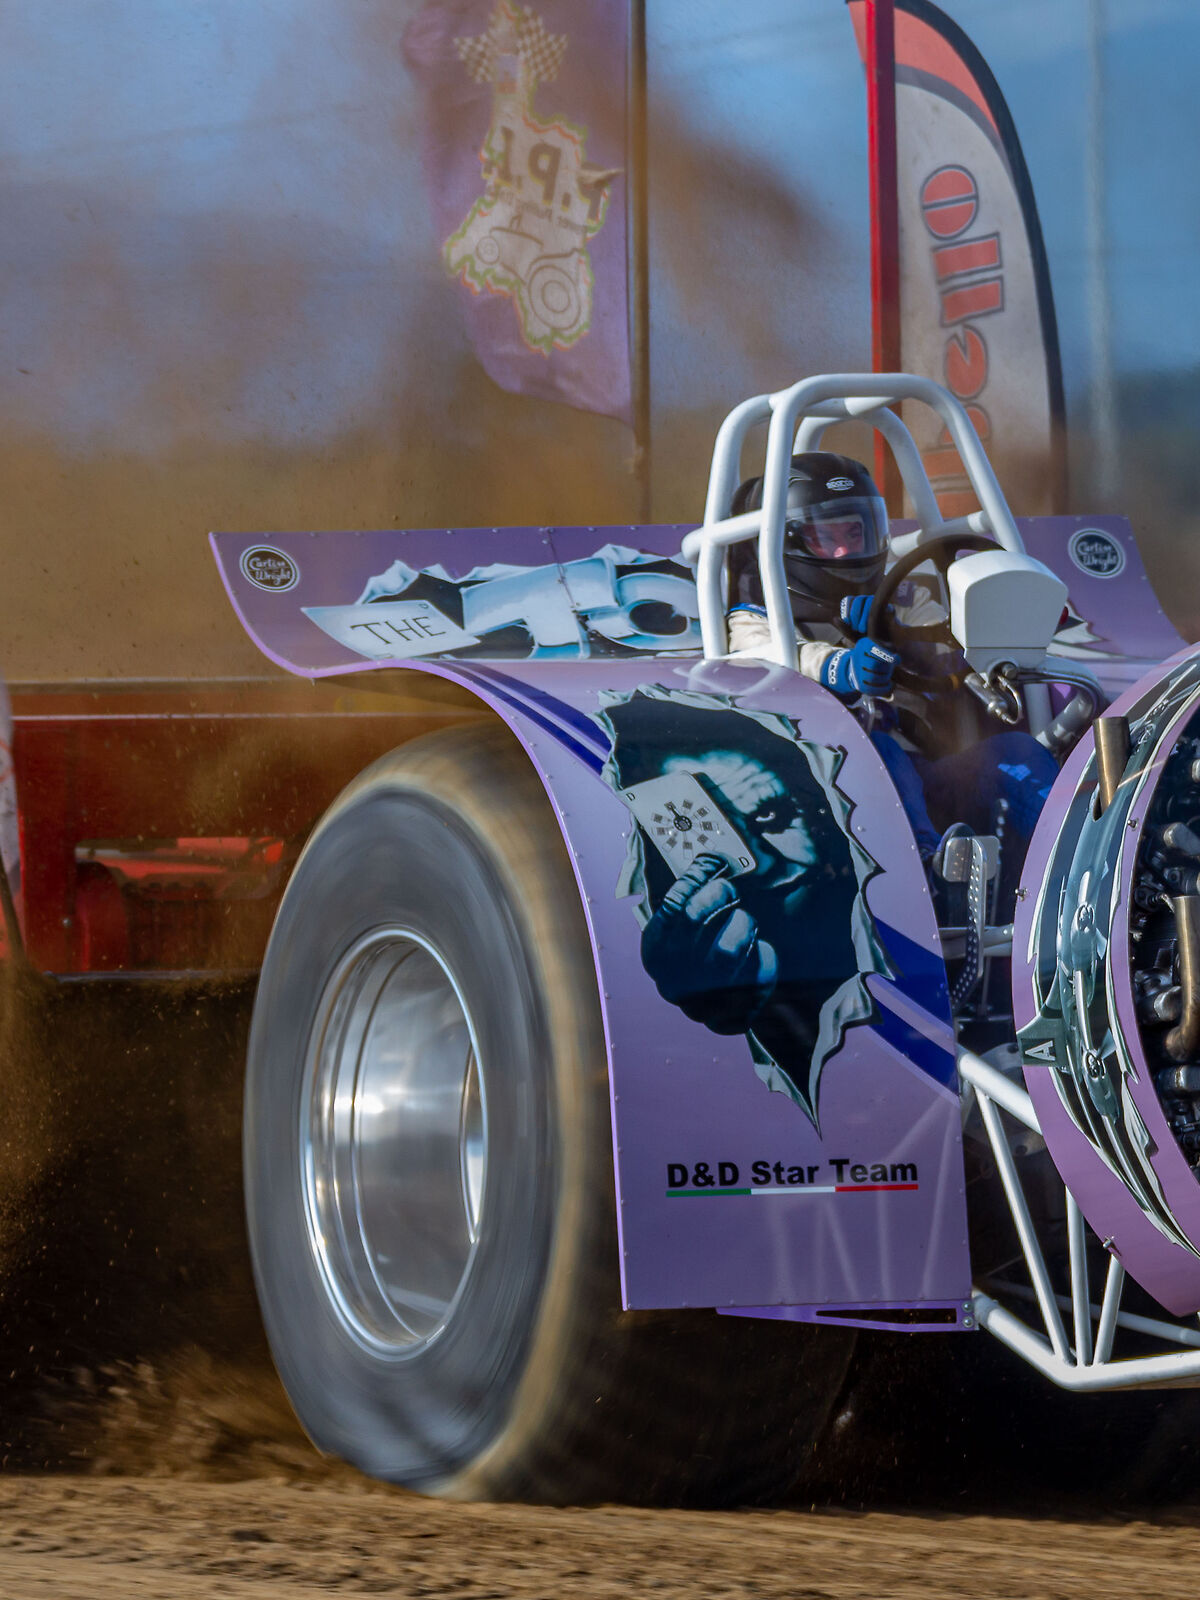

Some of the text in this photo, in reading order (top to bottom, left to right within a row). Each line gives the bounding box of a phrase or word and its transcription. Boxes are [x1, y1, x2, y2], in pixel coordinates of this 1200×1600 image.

[350, 616, 446, 644] THE
[739, 856, 750, 868] D
[666, 1158, 918, 1188] D&D Star Team
